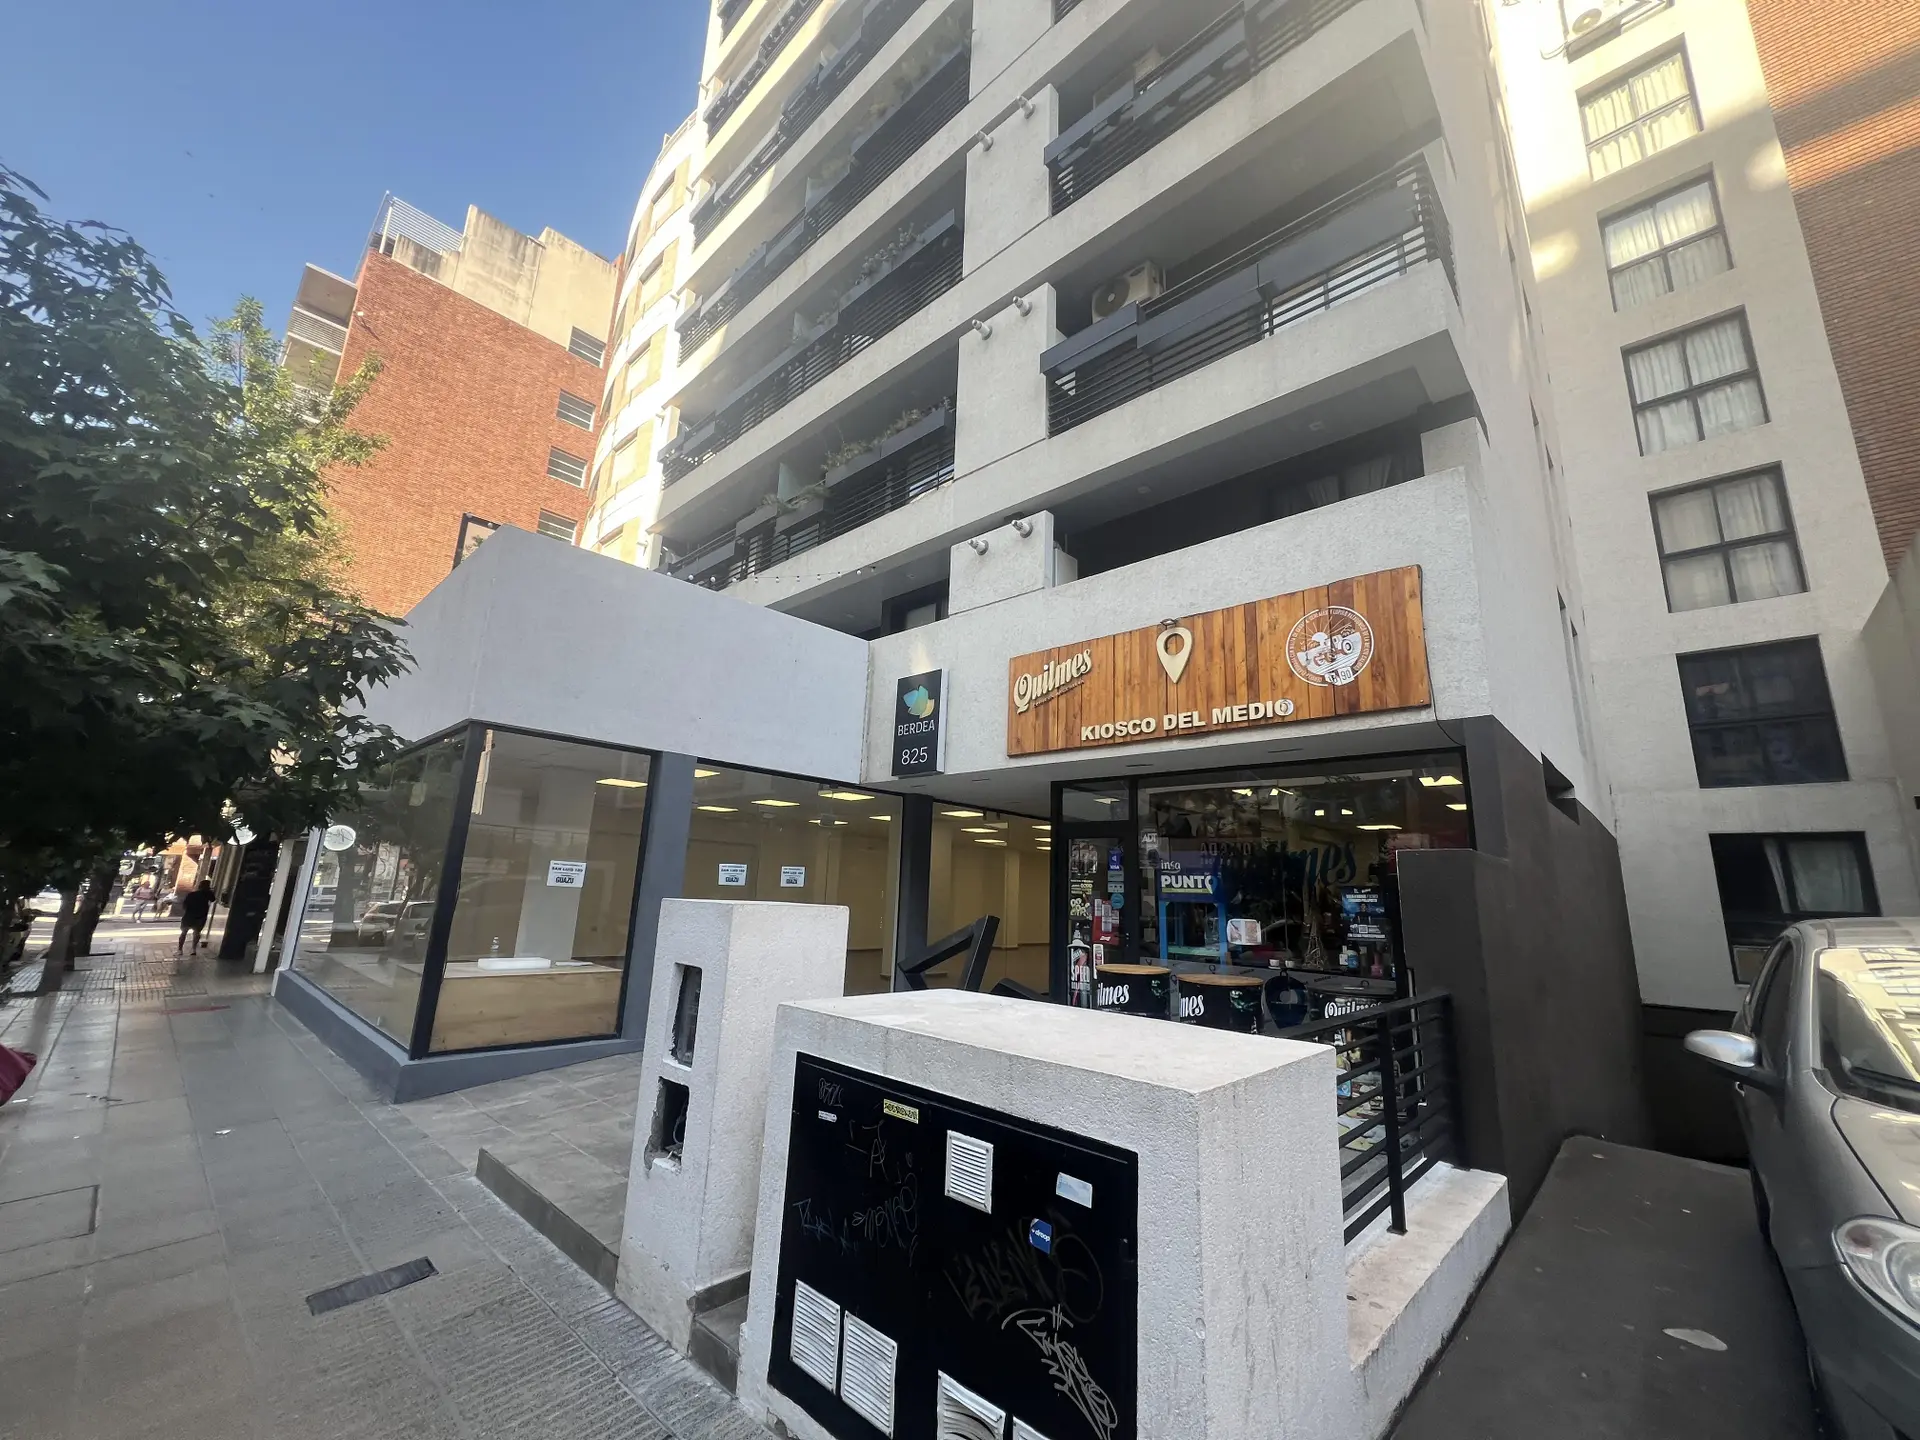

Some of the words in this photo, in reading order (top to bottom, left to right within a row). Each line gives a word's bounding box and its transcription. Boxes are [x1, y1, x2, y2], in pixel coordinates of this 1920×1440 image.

[1013, 648, 1092, 715] Quilmes
[897, 720, 935, 736] BERDEA
[1081, 717, 1157, 741] KIOSCO
[1163, 711, 1206, 731] DEL
[1212, 699, 1295, 725] MEDIO
[901, 746, 928, 766] 825
[1141, 833, 1158, 842] ADT
